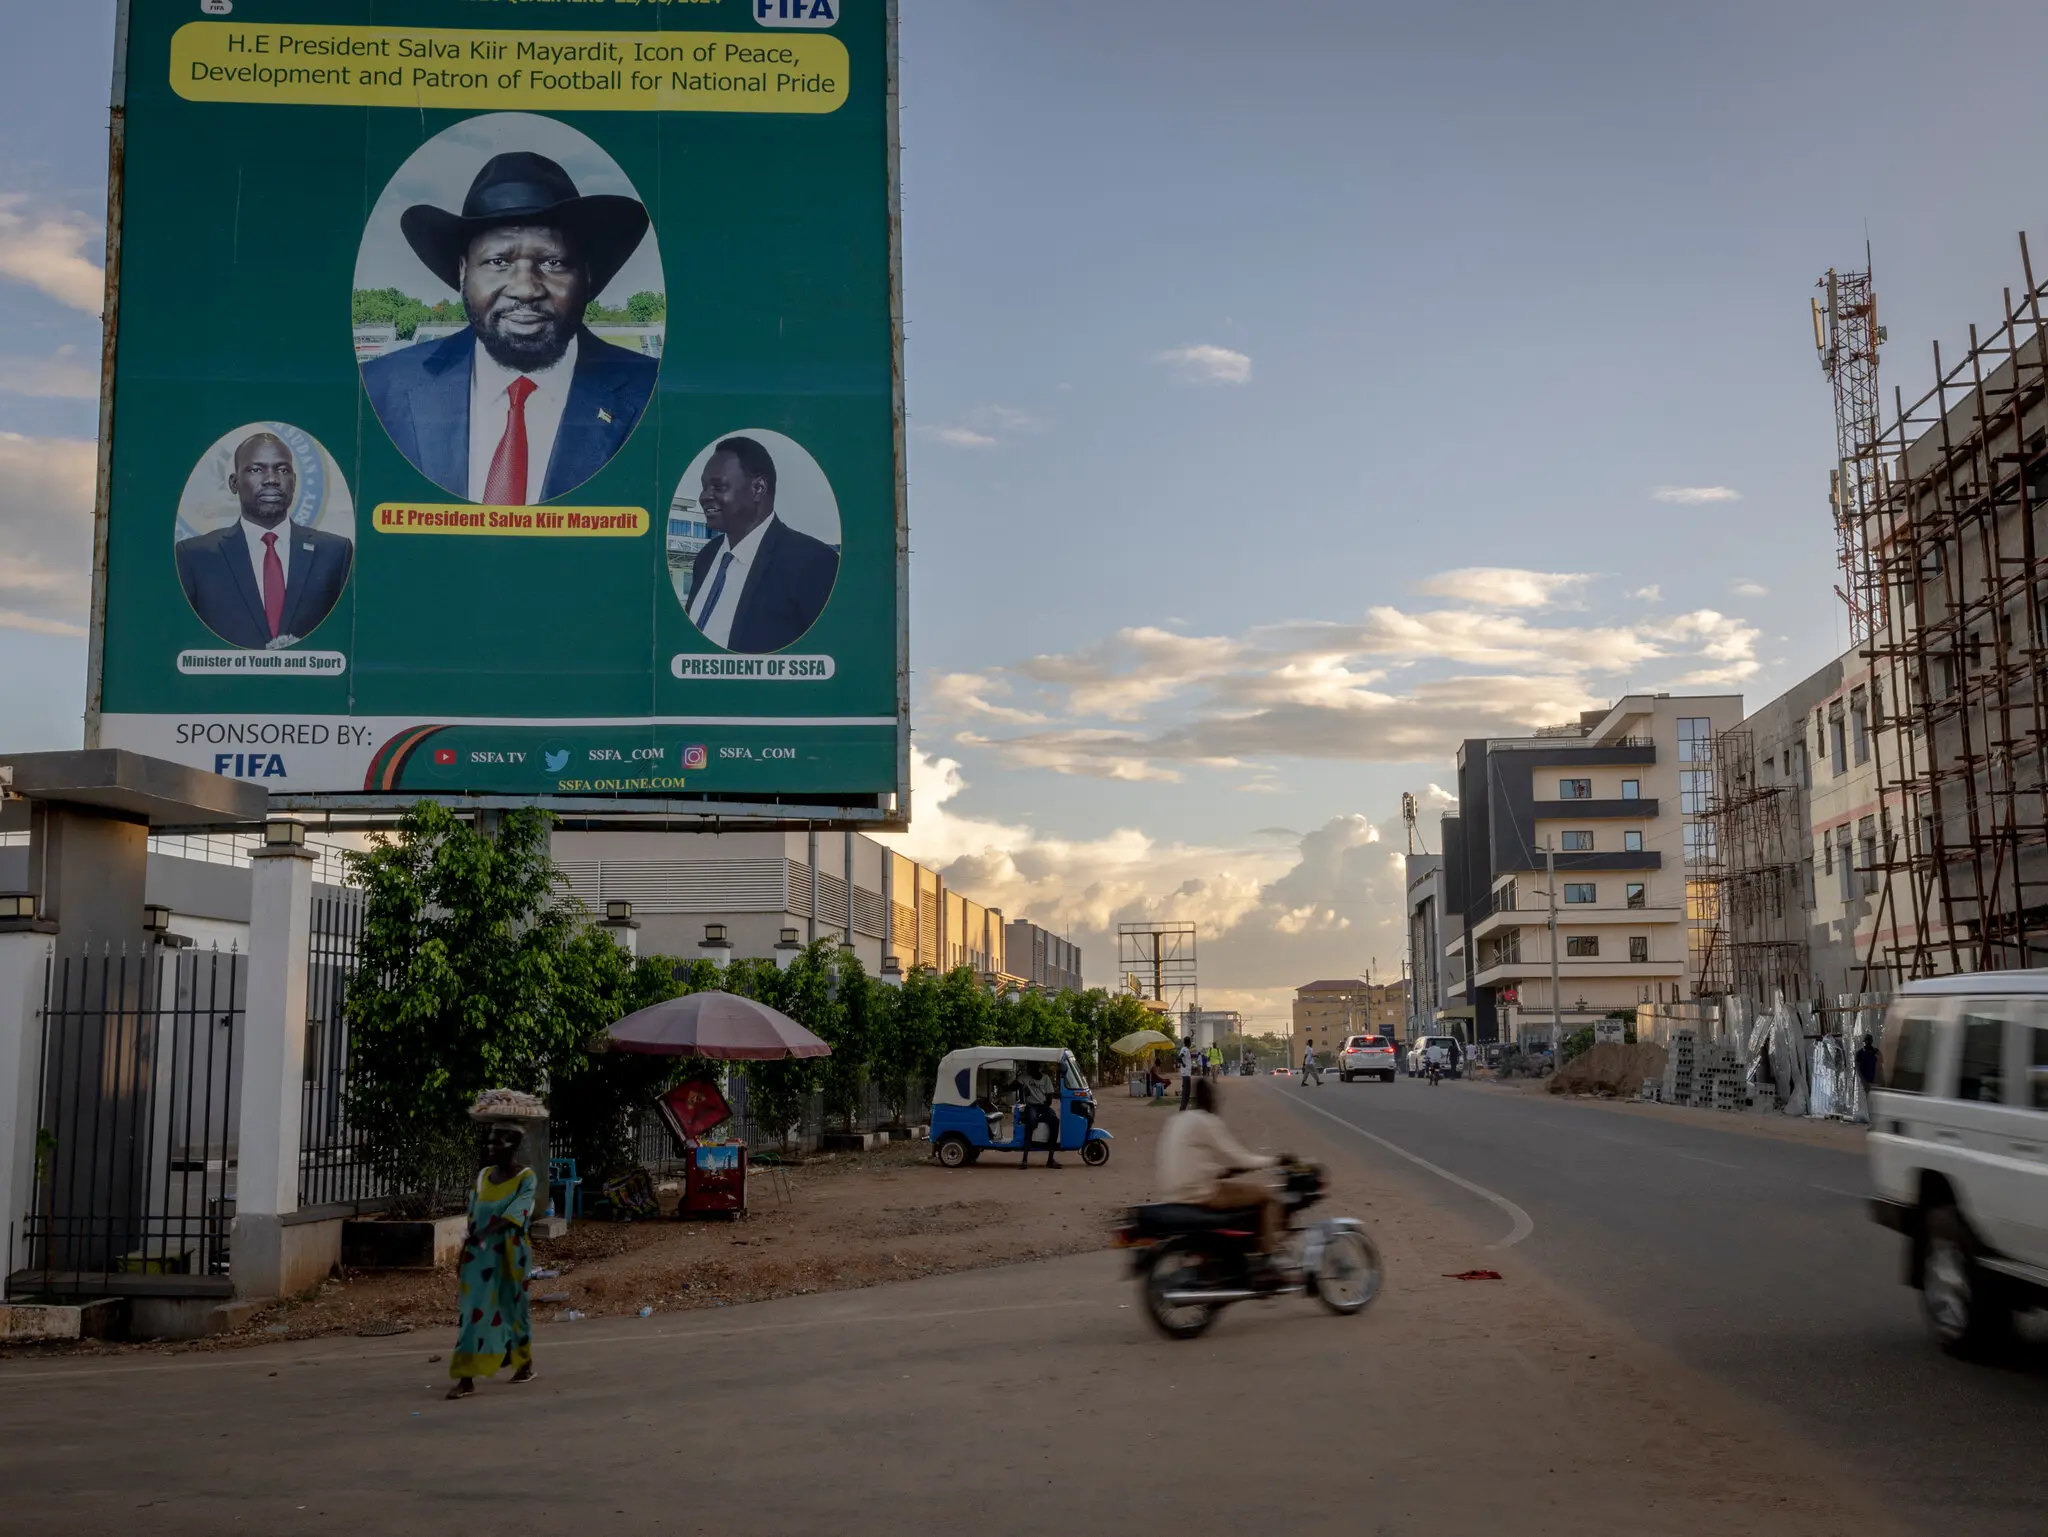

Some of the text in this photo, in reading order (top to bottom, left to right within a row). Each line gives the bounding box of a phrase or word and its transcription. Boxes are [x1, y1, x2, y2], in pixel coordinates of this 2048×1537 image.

[758, 0, 834, 19] FIFA
[229, 34, 799, 67] H.E President Salva Kiir Mayardit, Icon of Peace,
[192, 62, 834, 92] Development and Patron of Football for National Pride
[382, 510, 638, 530] H.E President Salva Kiir Mayardit
[182, 656, 341, 669] Minister of Youth and Sport
[682, 659, 825, 676] PRESIDENT OF SSFA
[176, 724, 371, 746] SPONSORED BY:
[215, 754, 287, 777] FIFA
[471, 752, 526, 763] SSFA TV
